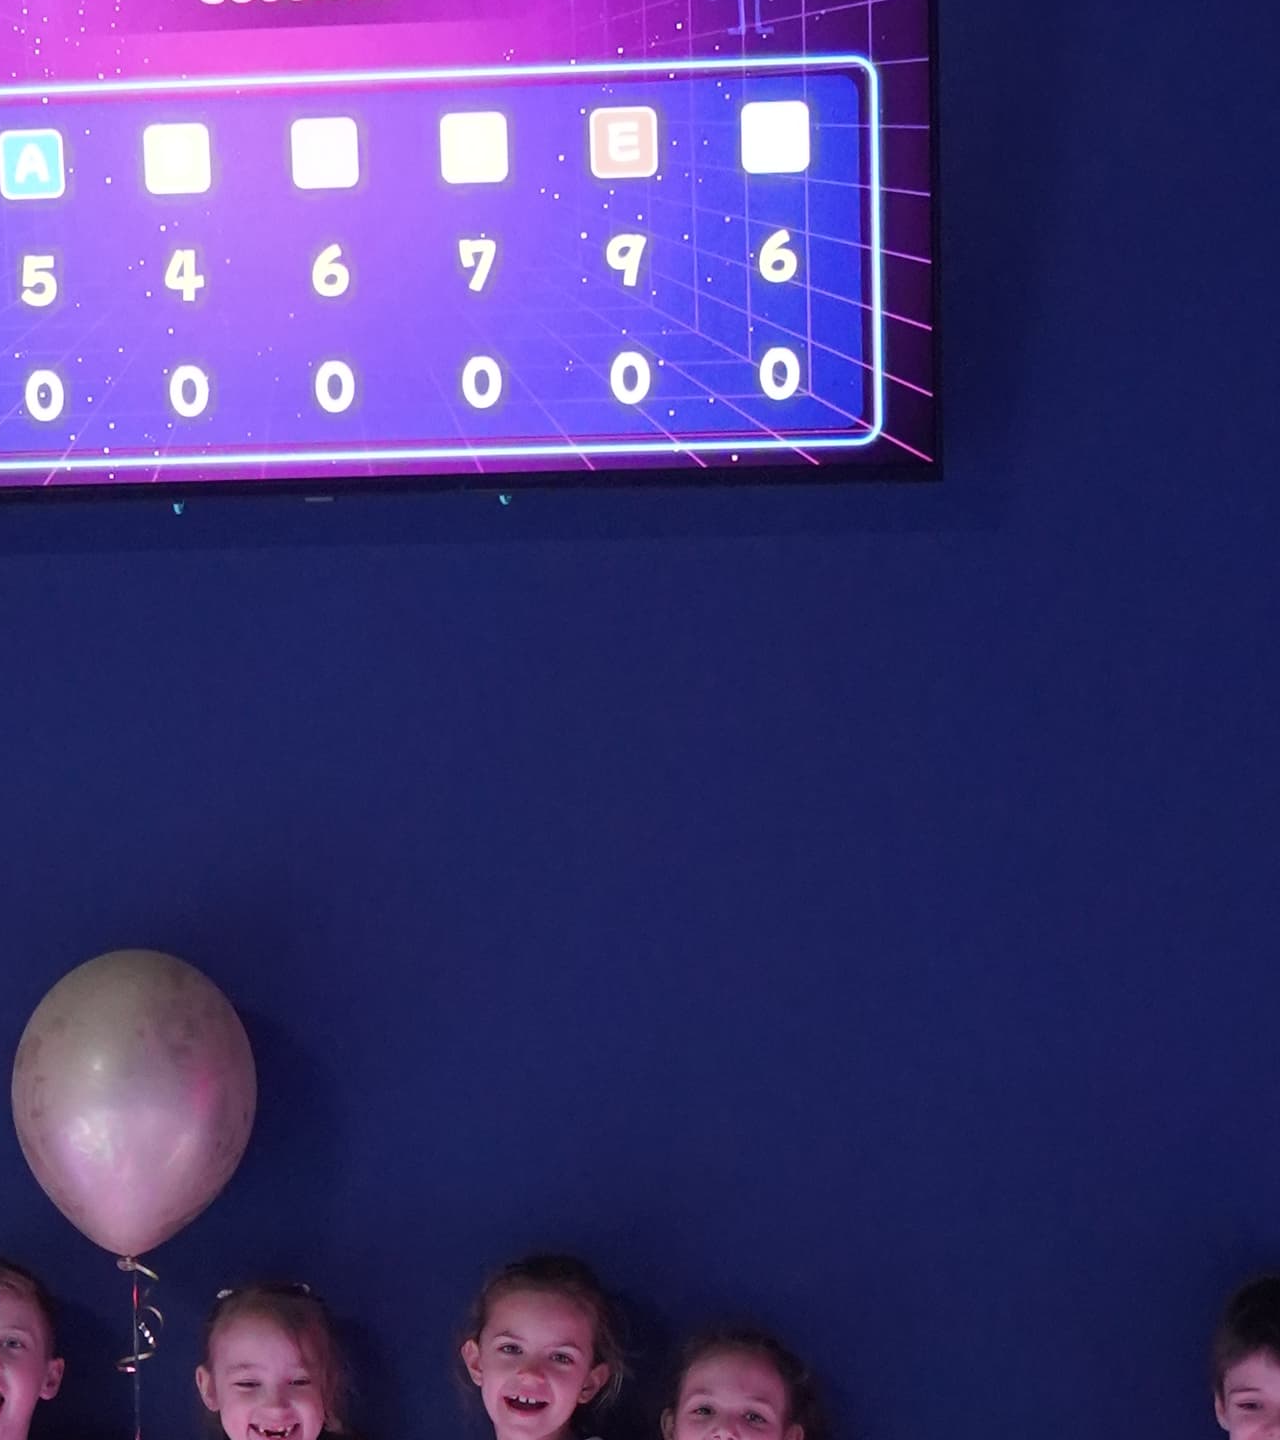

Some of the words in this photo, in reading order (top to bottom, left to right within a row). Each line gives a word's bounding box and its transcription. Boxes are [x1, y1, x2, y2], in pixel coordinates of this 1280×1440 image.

[13, 142, 52, 185] A
[607, 120, 641, 163] E
[21, 255, 58, 307] 5
[163, 249, 205, 302] 4
[312, 244, 350, 297] 6
[458, 239, 497, 291] 7
[606, 234, 647, 286] 9
[758, 229, 797, 283] 6
[25, 370, 64, 421] 0
[169, 365, 209, 418] 0
[315, 360, 355, 413] 0
[462, 356, 502, 409] 0
[610, 352, 650, 405] 0
[759, 348, 800, 401] 0
